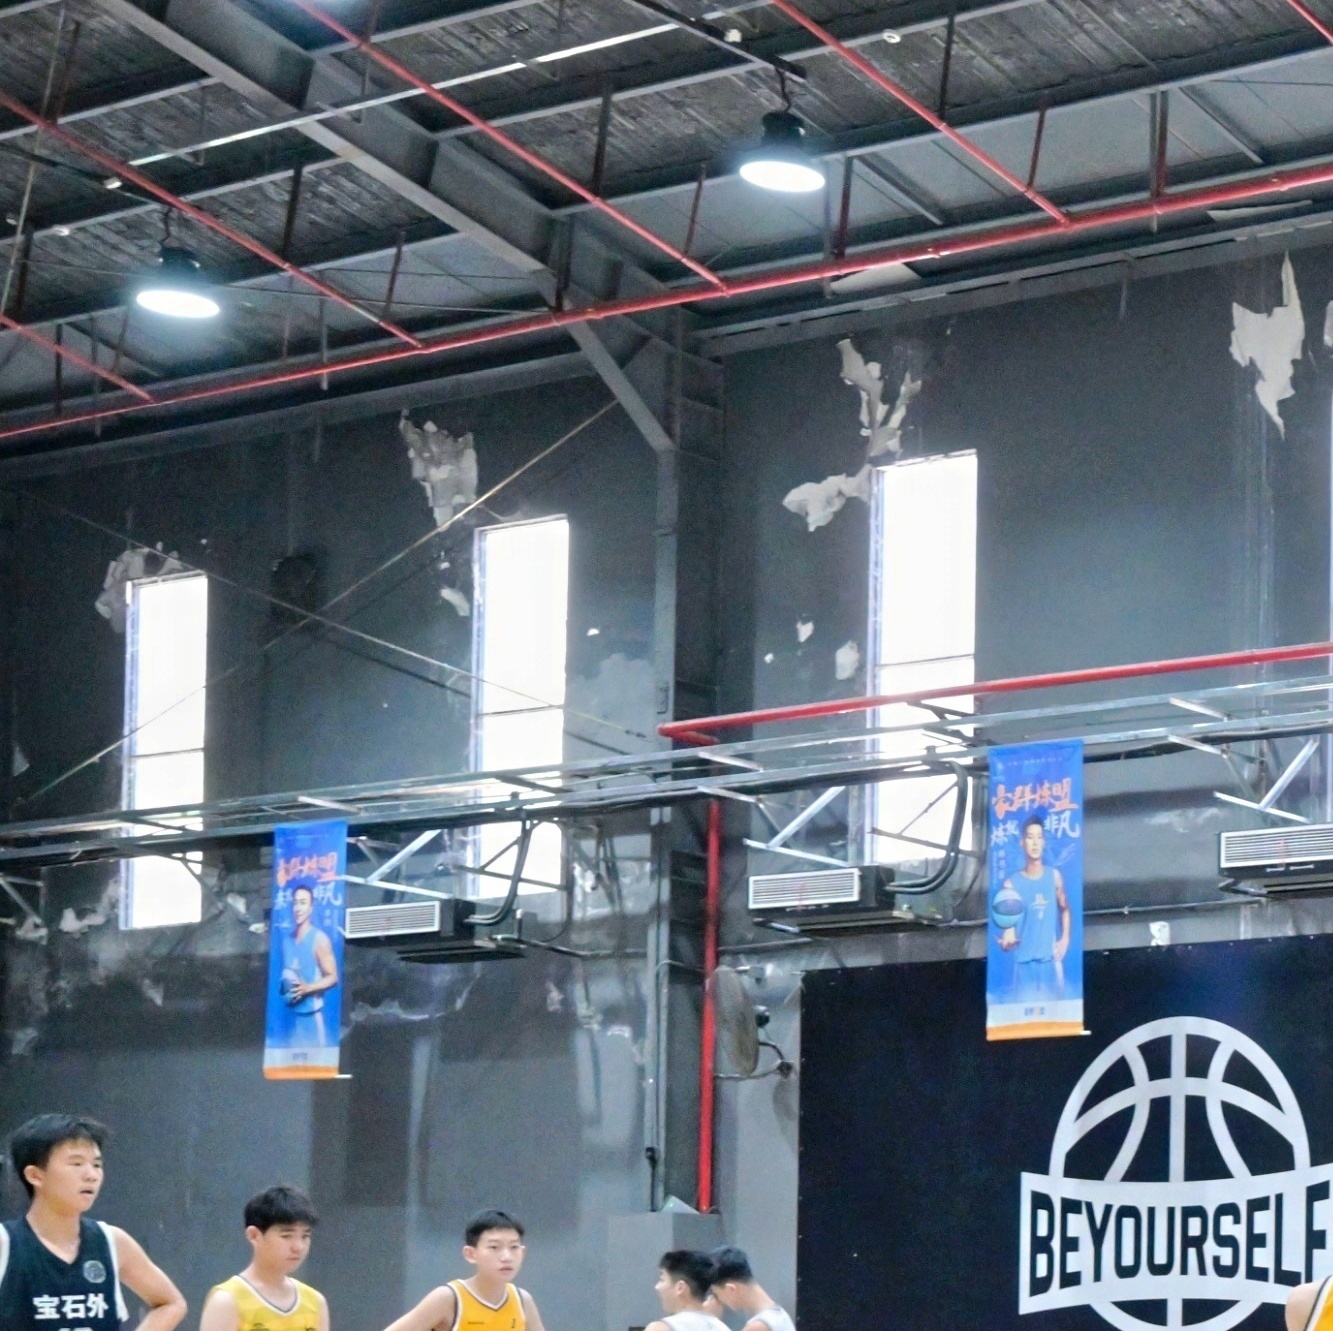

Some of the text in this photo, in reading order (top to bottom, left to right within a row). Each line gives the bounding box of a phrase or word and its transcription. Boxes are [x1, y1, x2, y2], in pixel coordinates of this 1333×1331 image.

[1029, 1180, 1331, 1298] BEYOURSELF
[32, 1293, 110, 1320] 宝石外
